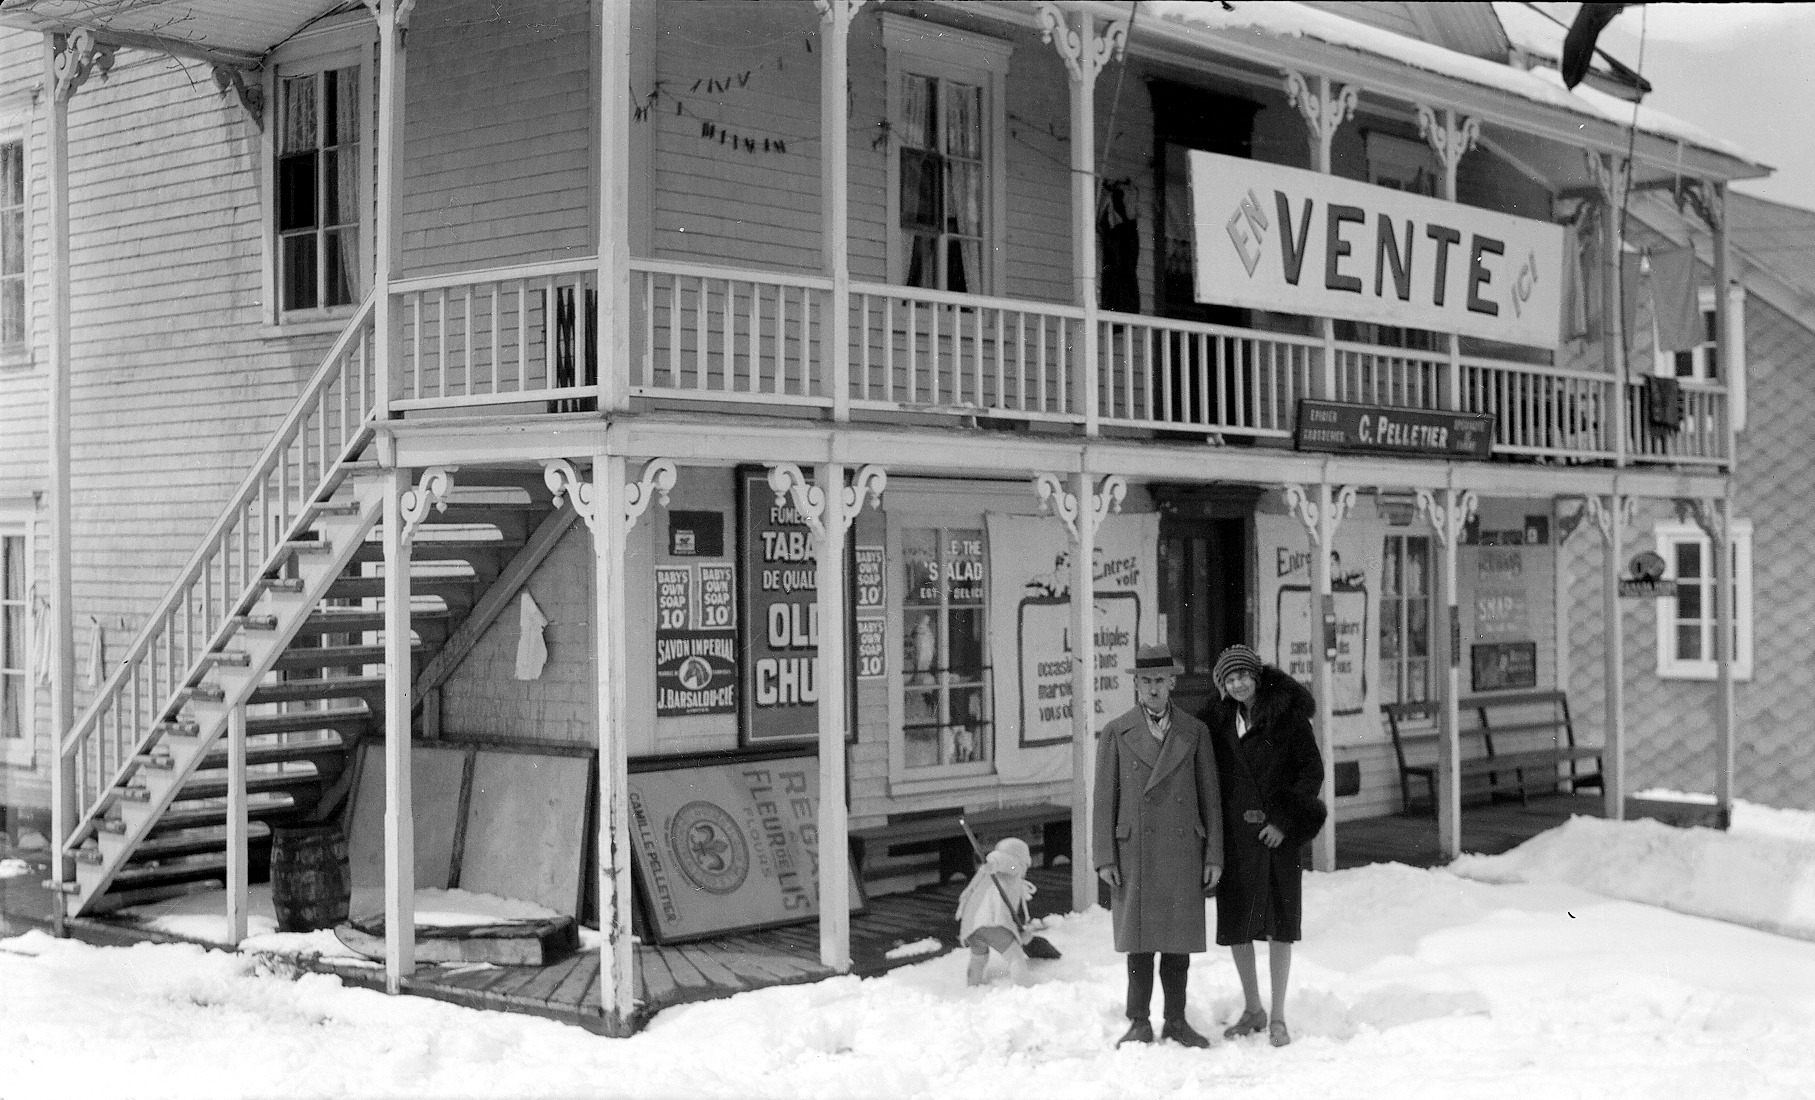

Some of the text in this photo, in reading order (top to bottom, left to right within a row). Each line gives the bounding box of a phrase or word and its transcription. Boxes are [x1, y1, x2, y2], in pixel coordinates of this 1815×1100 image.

[1226, 188, 1539, 319] EN VENTE ICI
[1358, 414, 1373, 445] C.
[1376, 415, 1449, 449] PELLETIER
[770, 506, 807, 525] FUME
[762, 531, 817, 561] TABA
[858, 563, 879, 574] OWN
[1276, 546, 1311, 577] Entre
[661, 584, 685, 596] OWN
[705, 580, 728, 593] OWN
[763, 570, 817, 594] DE QUAL
[857, 574, 881, 585] SOAP
[659, 596, 686, 608] SOAP
[704, 592, 730, 605] SOAP
[657, 639, 690, 665] SAVON
[859, 644, 883, 656] SOAP
[756, 657, 818, 705] CHU
[742, 770, 787, 847] FLEUR
[777, 871, 811, 911] LIS
[743, 807, 772, 878] FLOURS
[630, 792, 677, 923] CAMILLE PELLETIER
